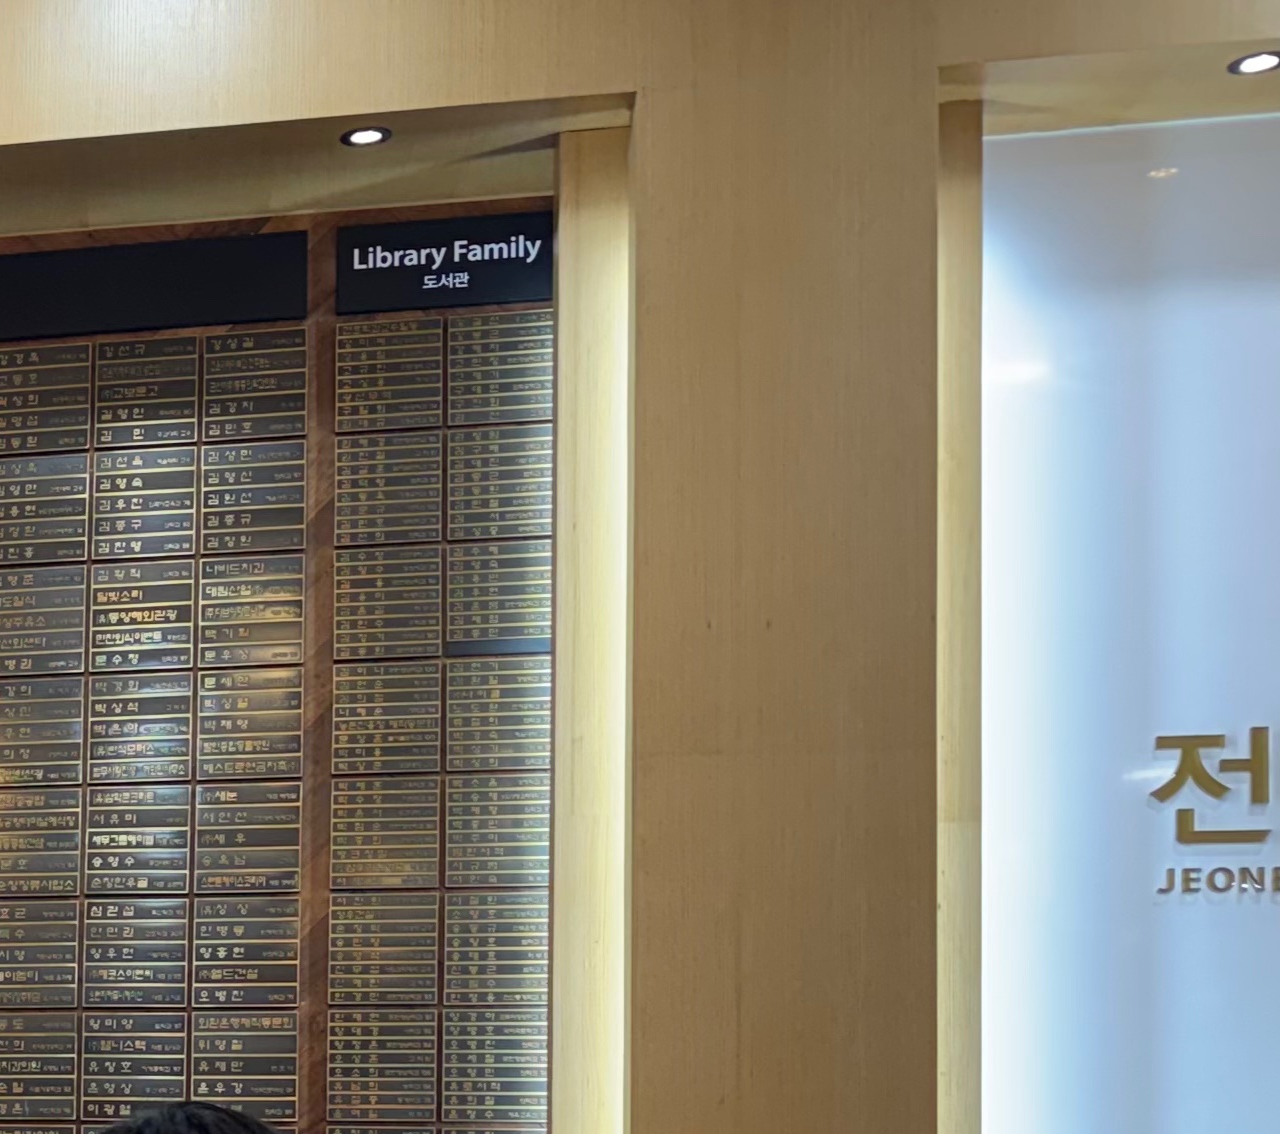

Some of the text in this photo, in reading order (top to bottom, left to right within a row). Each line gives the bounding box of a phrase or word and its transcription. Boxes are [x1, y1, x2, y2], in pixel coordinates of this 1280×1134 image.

[353, 235, 542, 271] Library Family
[422, 272, 469, 289] 도서관
[1149, 727, 1272, 844] 전
